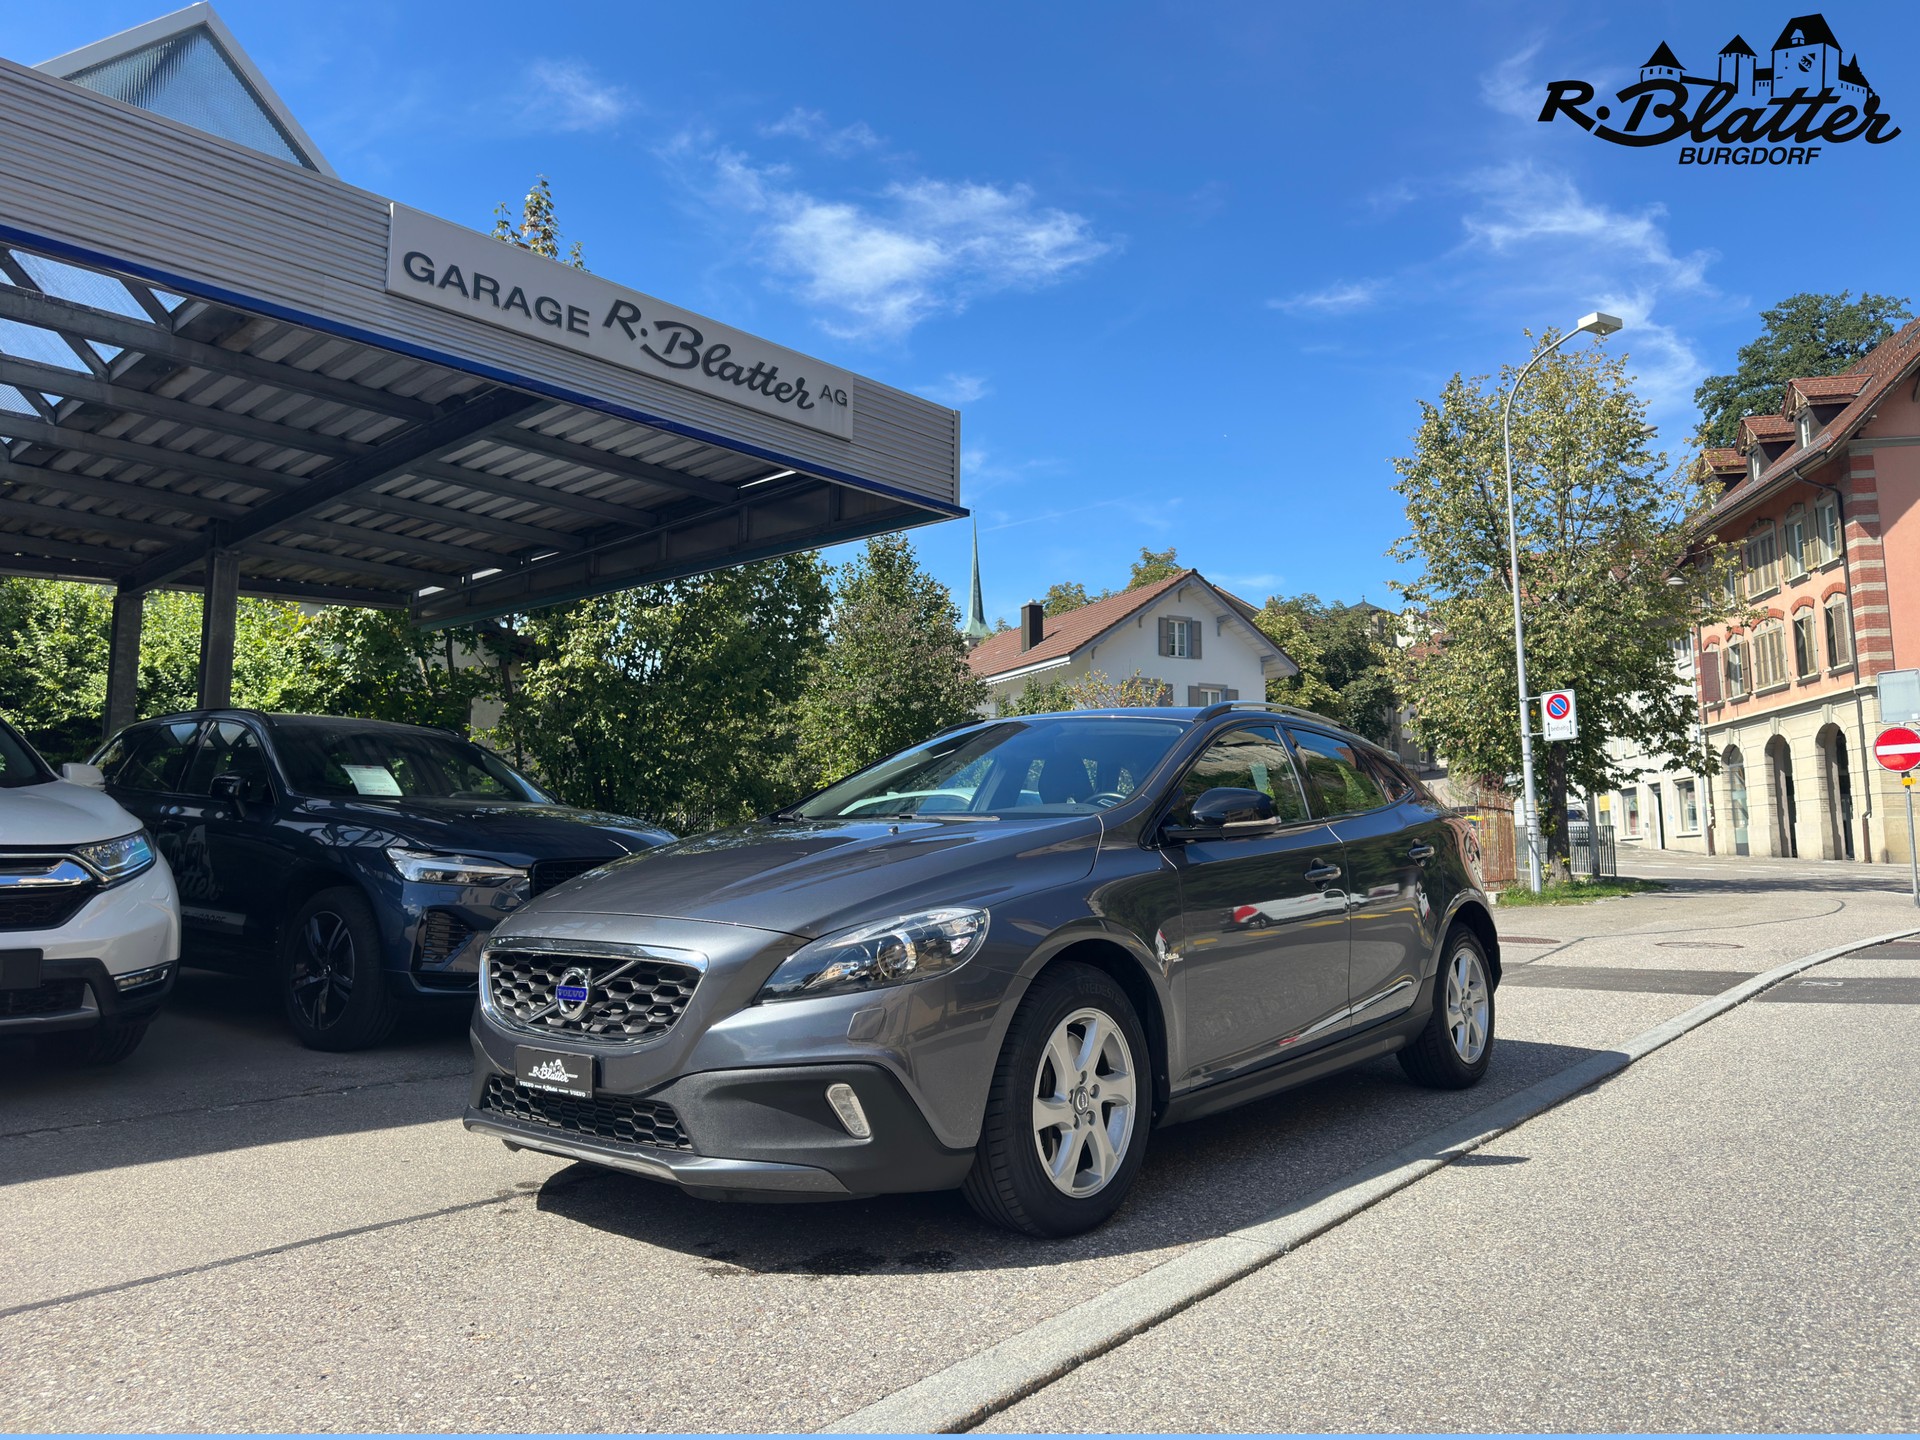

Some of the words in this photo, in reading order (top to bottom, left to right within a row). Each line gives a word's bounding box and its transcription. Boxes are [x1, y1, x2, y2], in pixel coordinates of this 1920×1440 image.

[403, 250, 590, 338] GARAGE
[819, 384, 848, 407] AG
[558, 988, 585, 998] VOLVO
